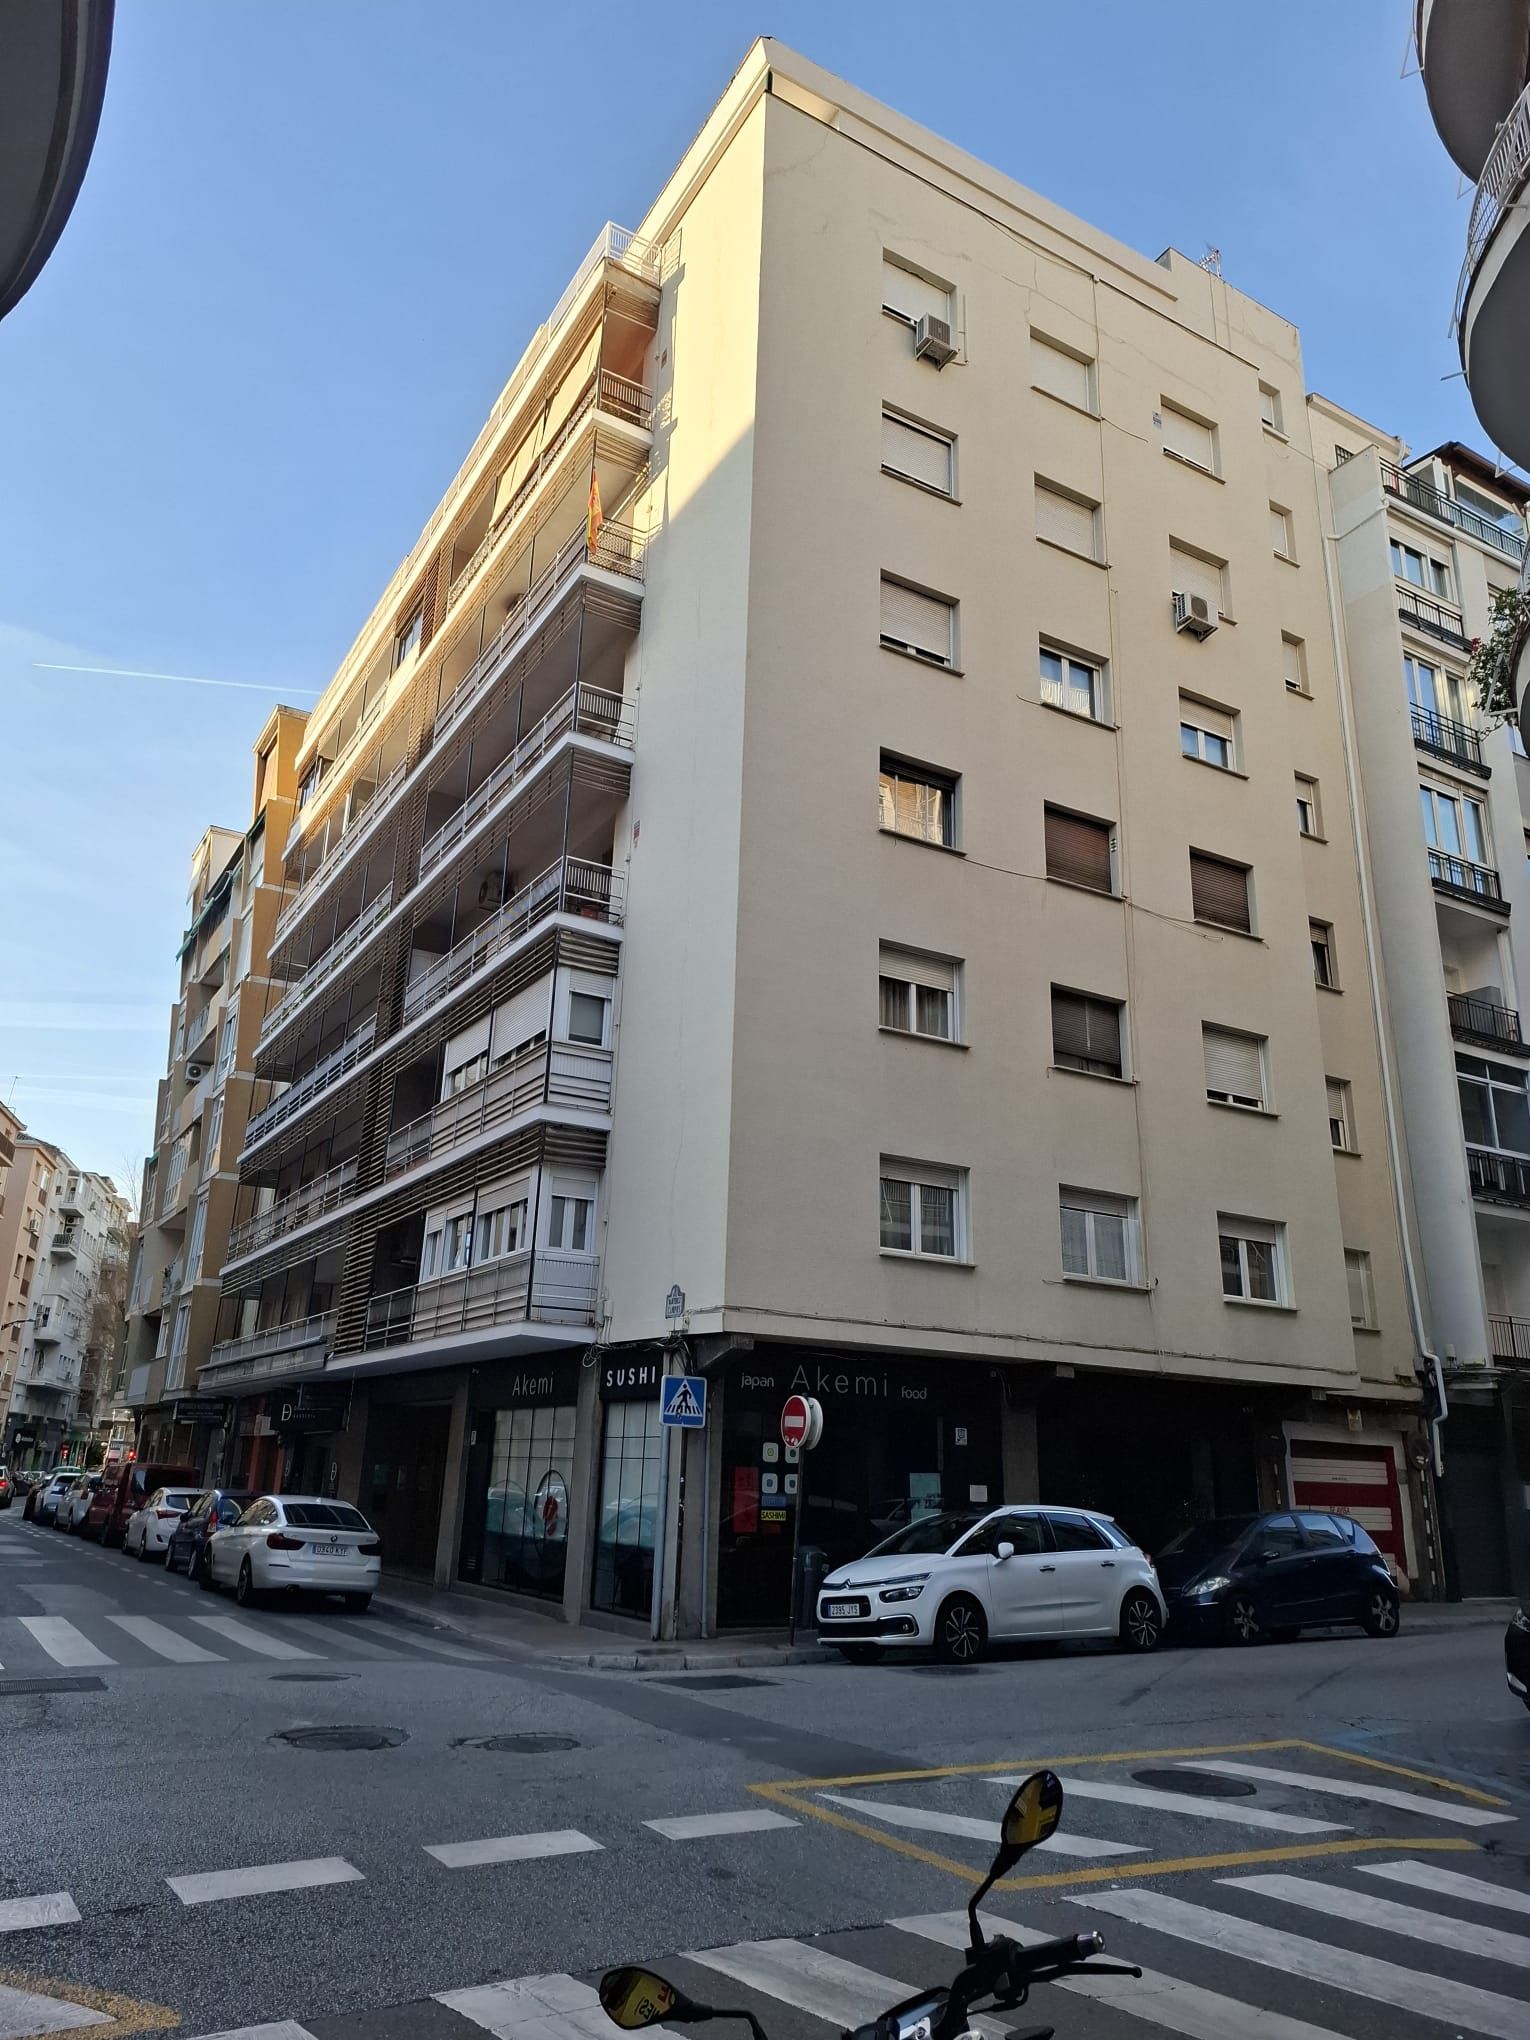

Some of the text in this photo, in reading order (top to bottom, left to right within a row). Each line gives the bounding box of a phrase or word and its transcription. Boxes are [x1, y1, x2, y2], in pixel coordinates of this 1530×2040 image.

[512, 1371, 554, 1397] Akemi
[606, 1366, 656, 1387] SUSHI
[740, 1364, 928, 1400] japan Akemi food
